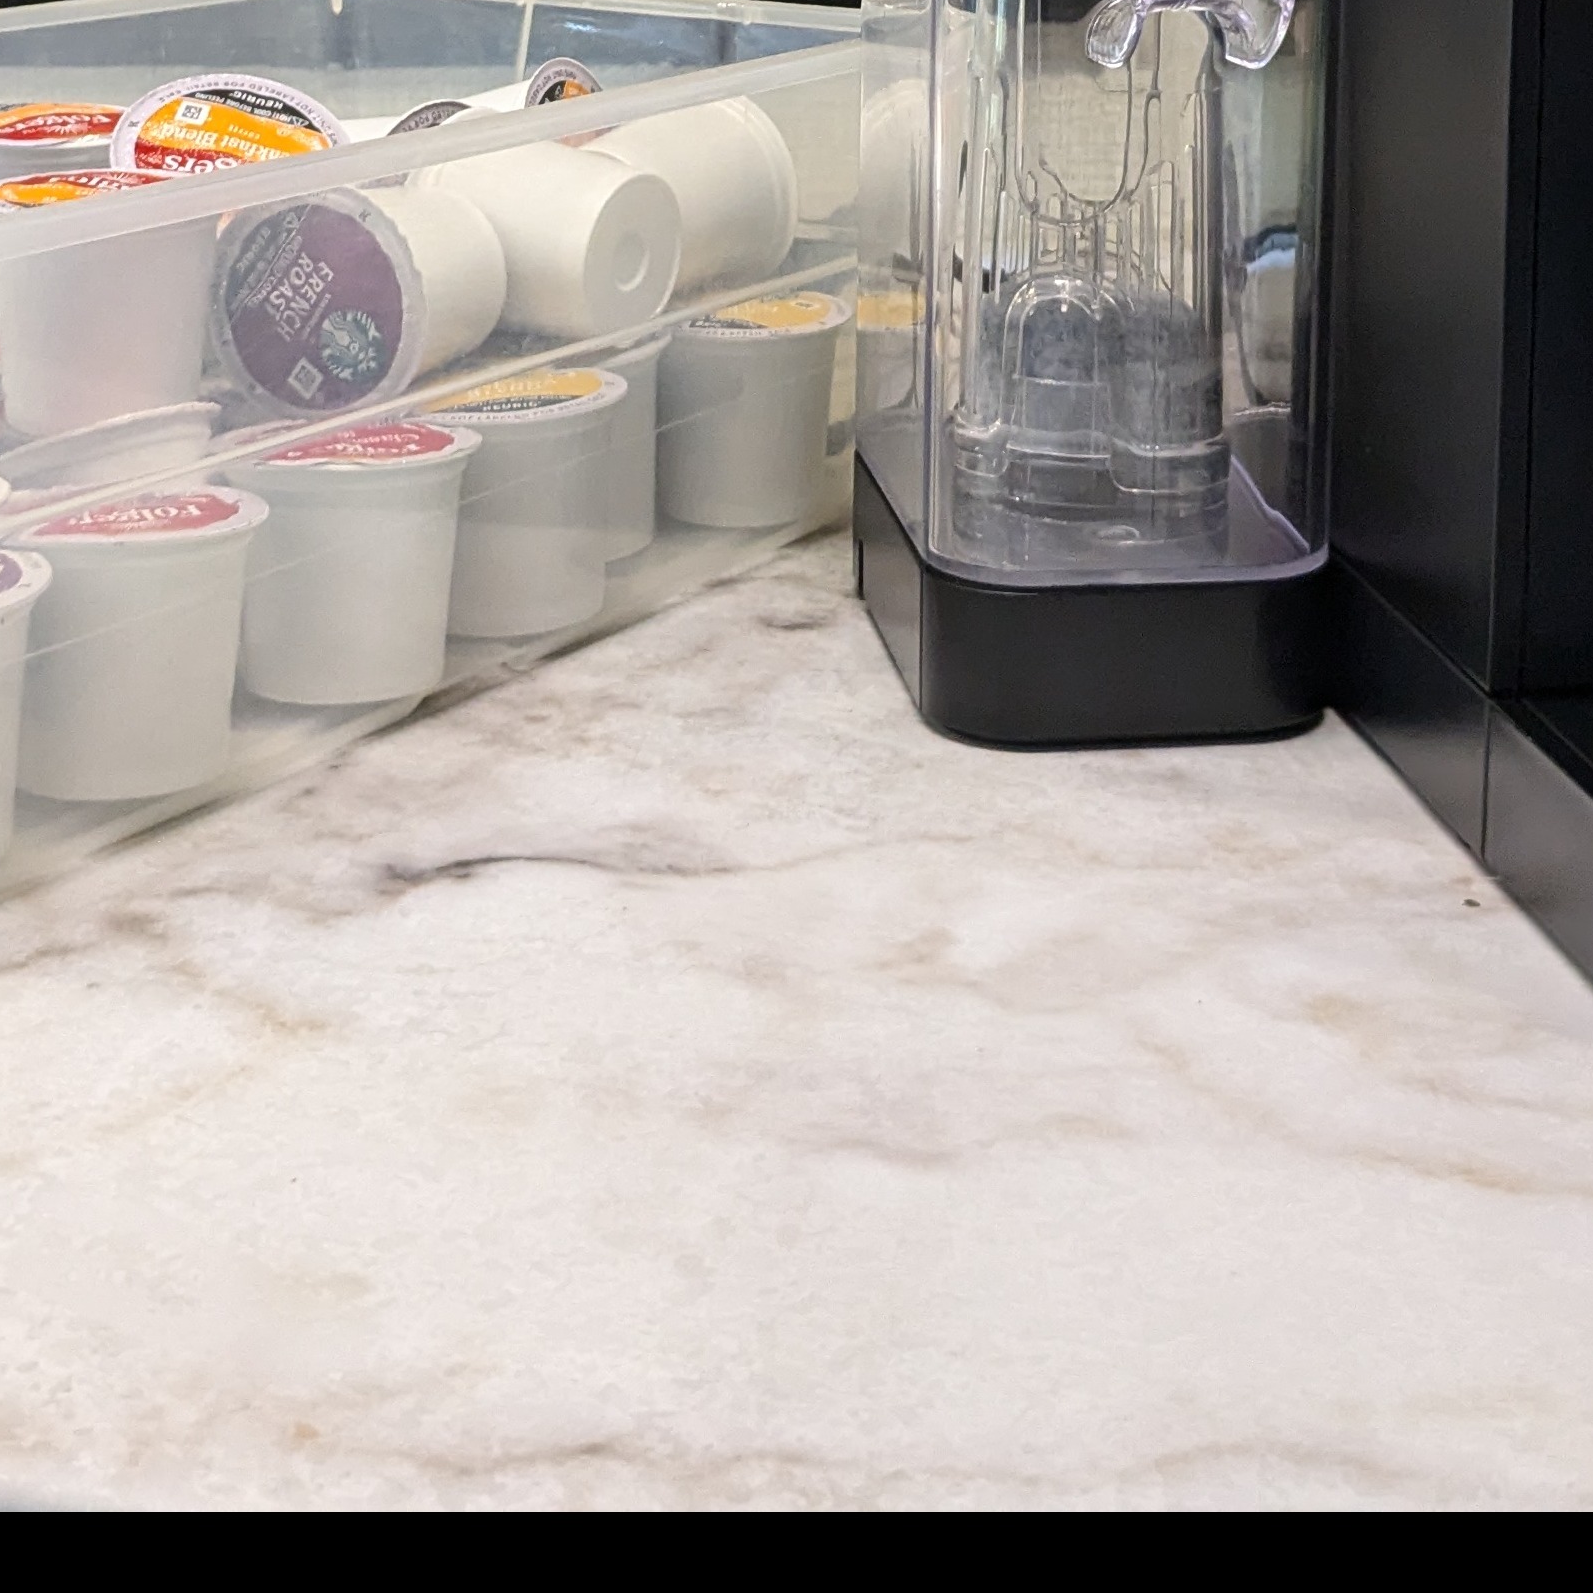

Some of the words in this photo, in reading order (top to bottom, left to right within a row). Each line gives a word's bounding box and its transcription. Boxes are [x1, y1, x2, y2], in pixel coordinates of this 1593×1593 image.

[232, 89, 284, 110] KEURIG
[248, 82, 295, 103] LABELED
[159, 122, 218, 150] Blend
[265, 252, 313, 321] ROAST
[277, 261, 335, 343] FRENCH
